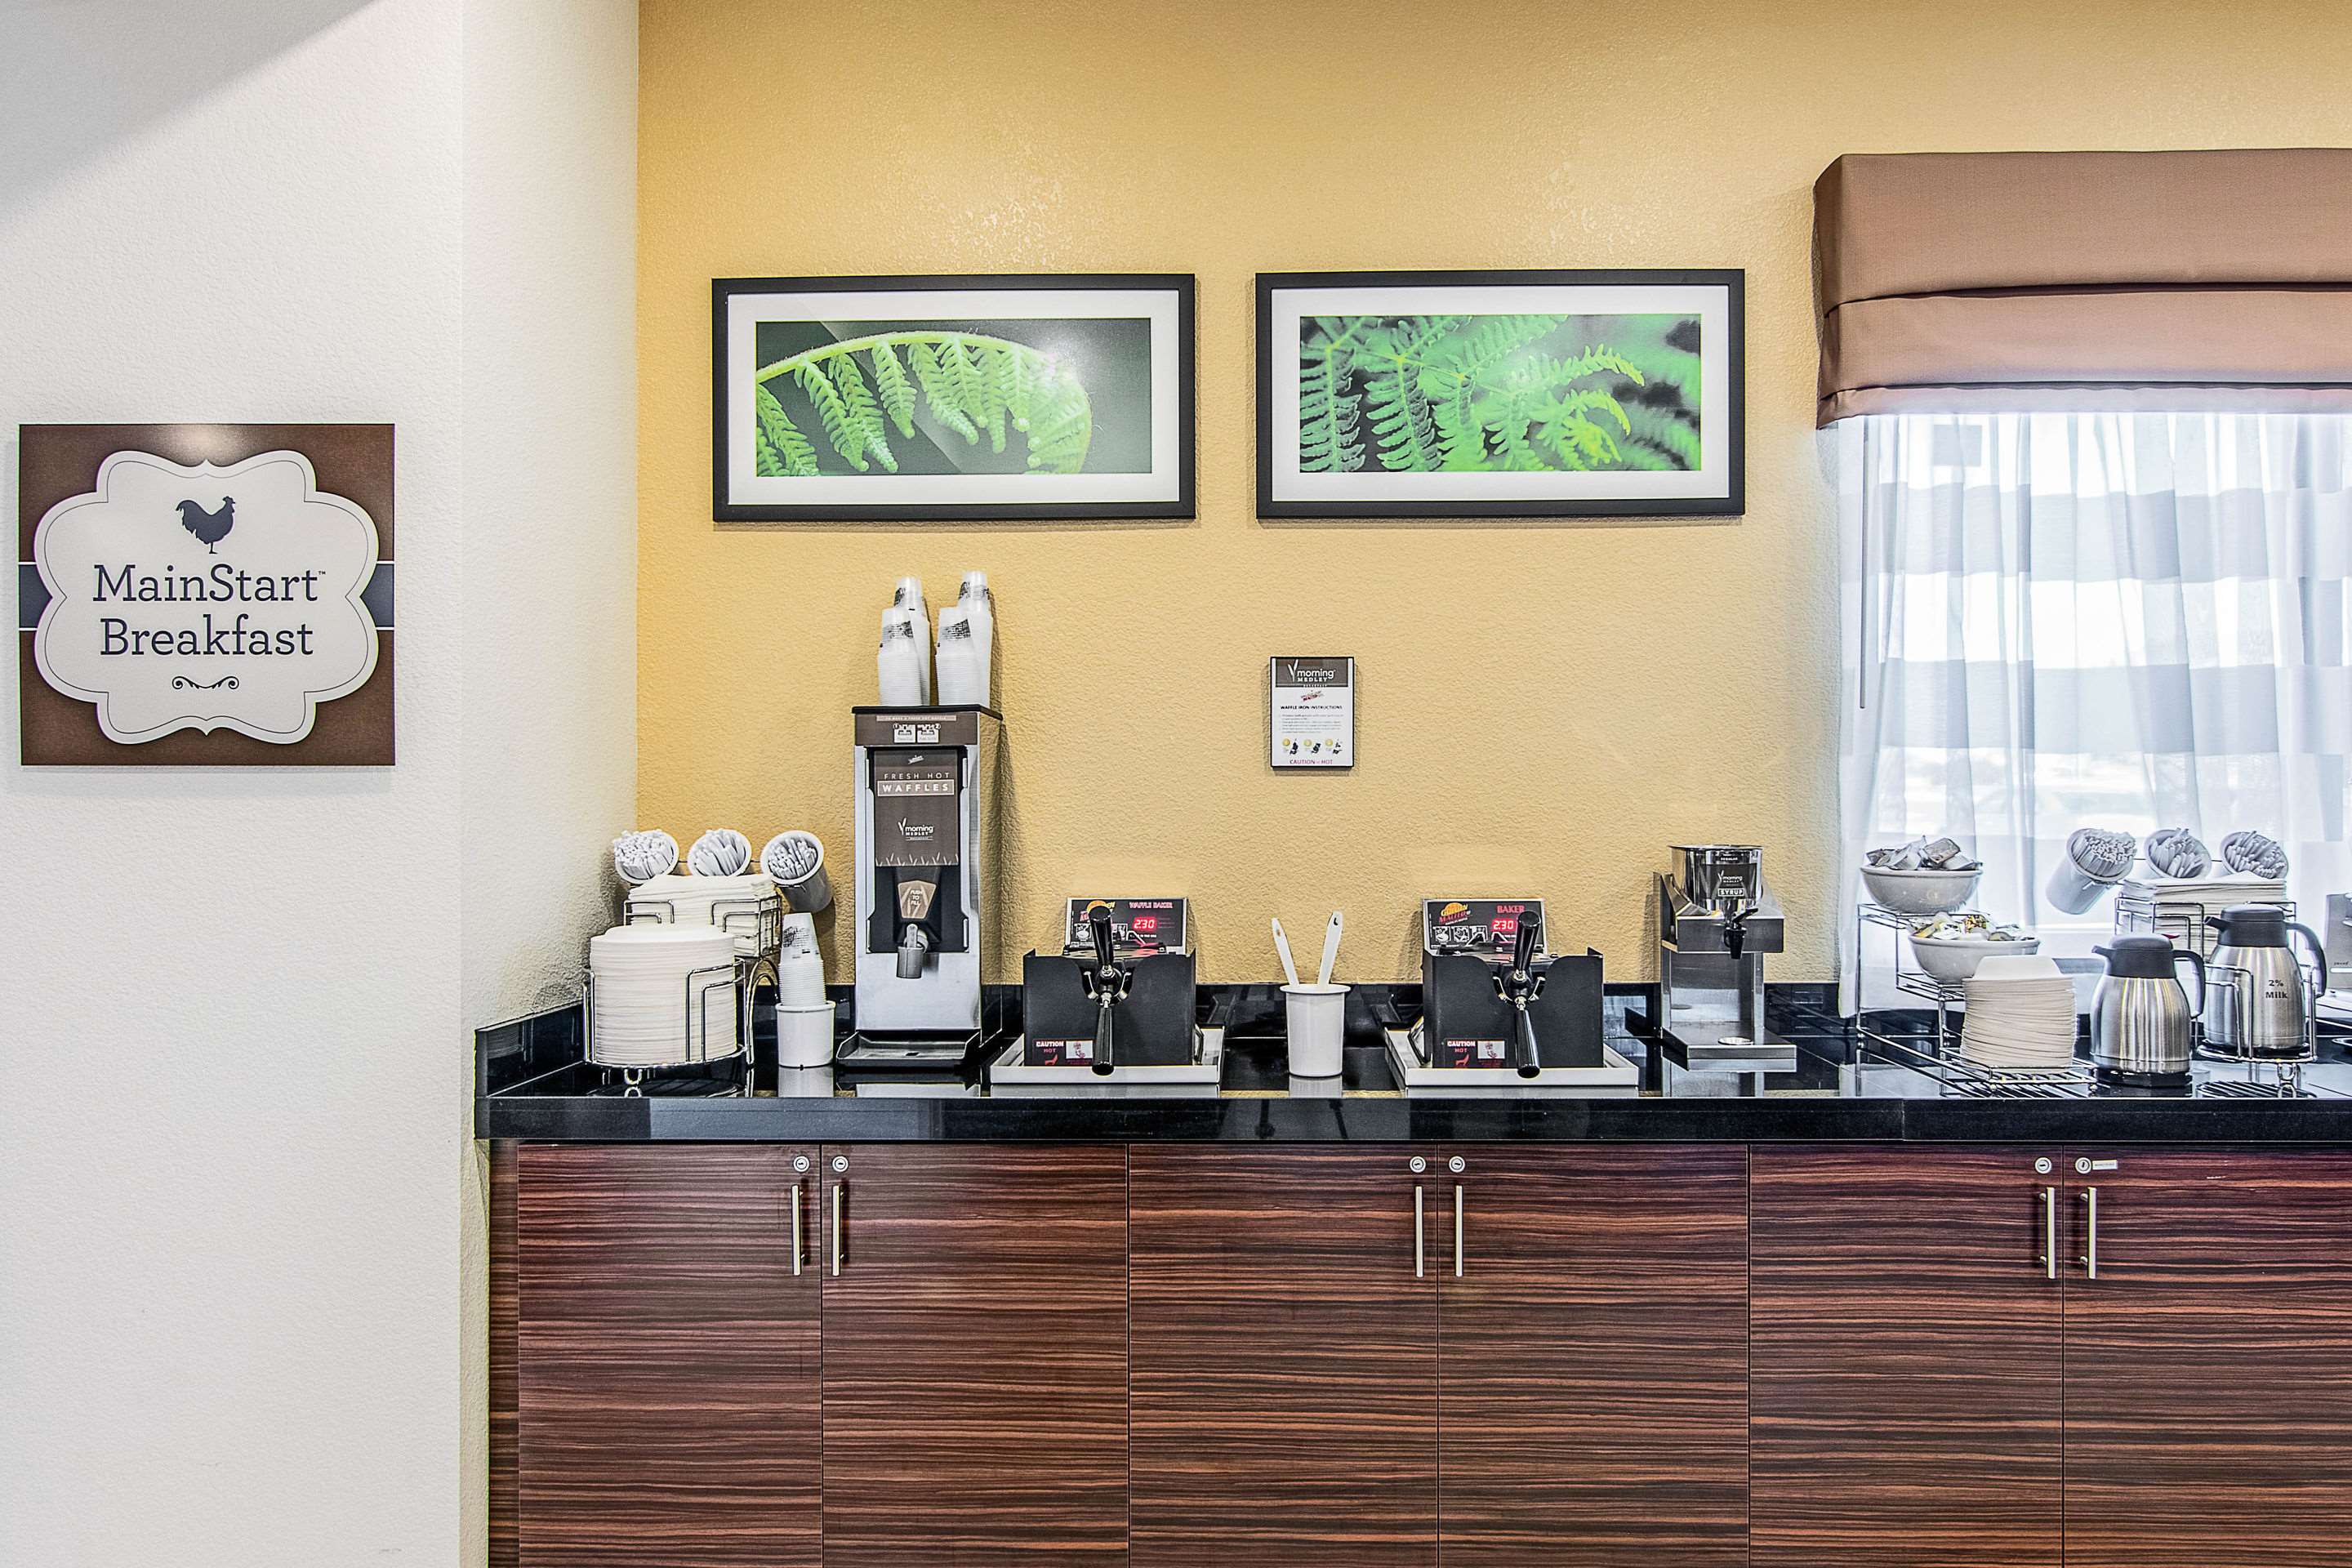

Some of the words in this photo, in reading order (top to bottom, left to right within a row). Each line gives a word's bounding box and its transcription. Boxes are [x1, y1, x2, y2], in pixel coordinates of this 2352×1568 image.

[100, 612, 314, 656] Breakfast
[1297, 669, 1334, 679] morning
[882, 783, 949, 792] WAFFLES
[905, 824, 934, 833] morning
[1497, 905, 1525, 914] BAKER
[2268, 979, 2284, 987] 2%
[2265, 991, 2288, 999] Milk
